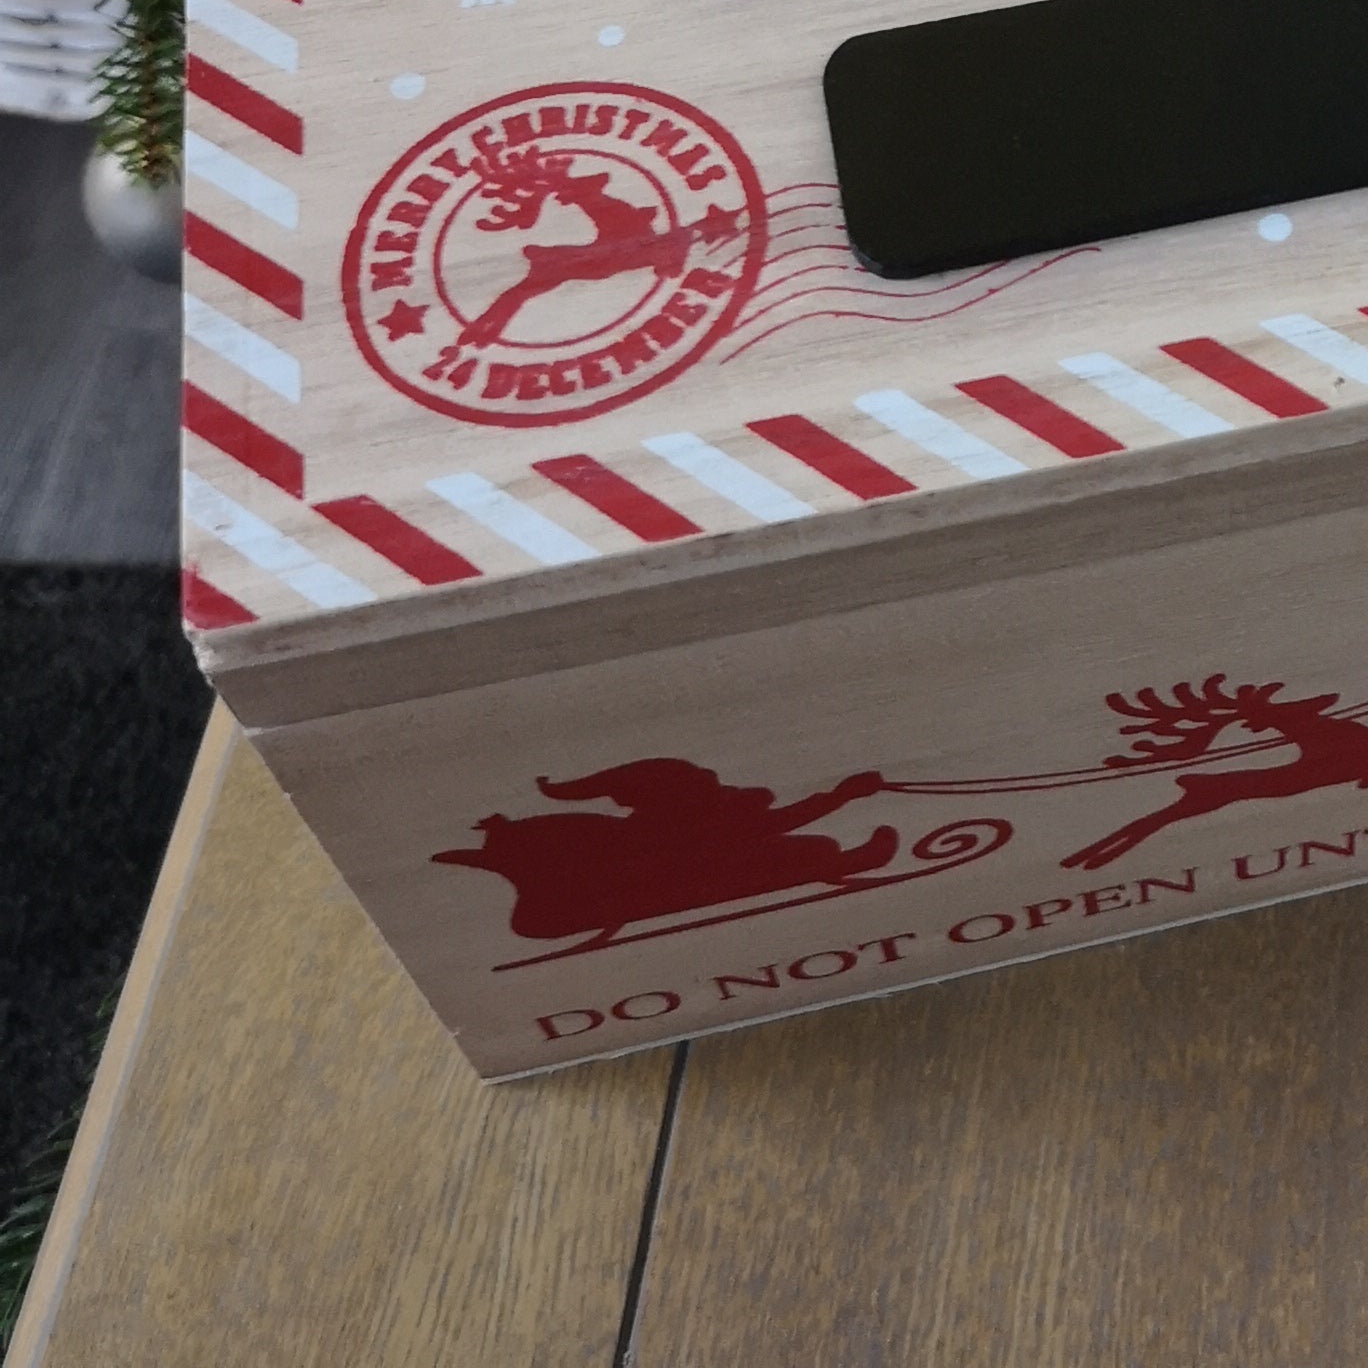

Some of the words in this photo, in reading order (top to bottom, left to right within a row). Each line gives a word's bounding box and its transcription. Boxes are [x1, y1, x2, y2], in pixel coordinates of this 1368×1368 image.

[369, 147, 473, 292] MERRY
[471, 103, 727, 192] CHRISTMAS
[421, 345, 478, 391] 24
[480, 267, 739, 401] DECEMBER
[534, 990, 682, 1043] DO
[714, 931, 918, 1002] NOT
[947, 865, 1199, 945] OPEN
